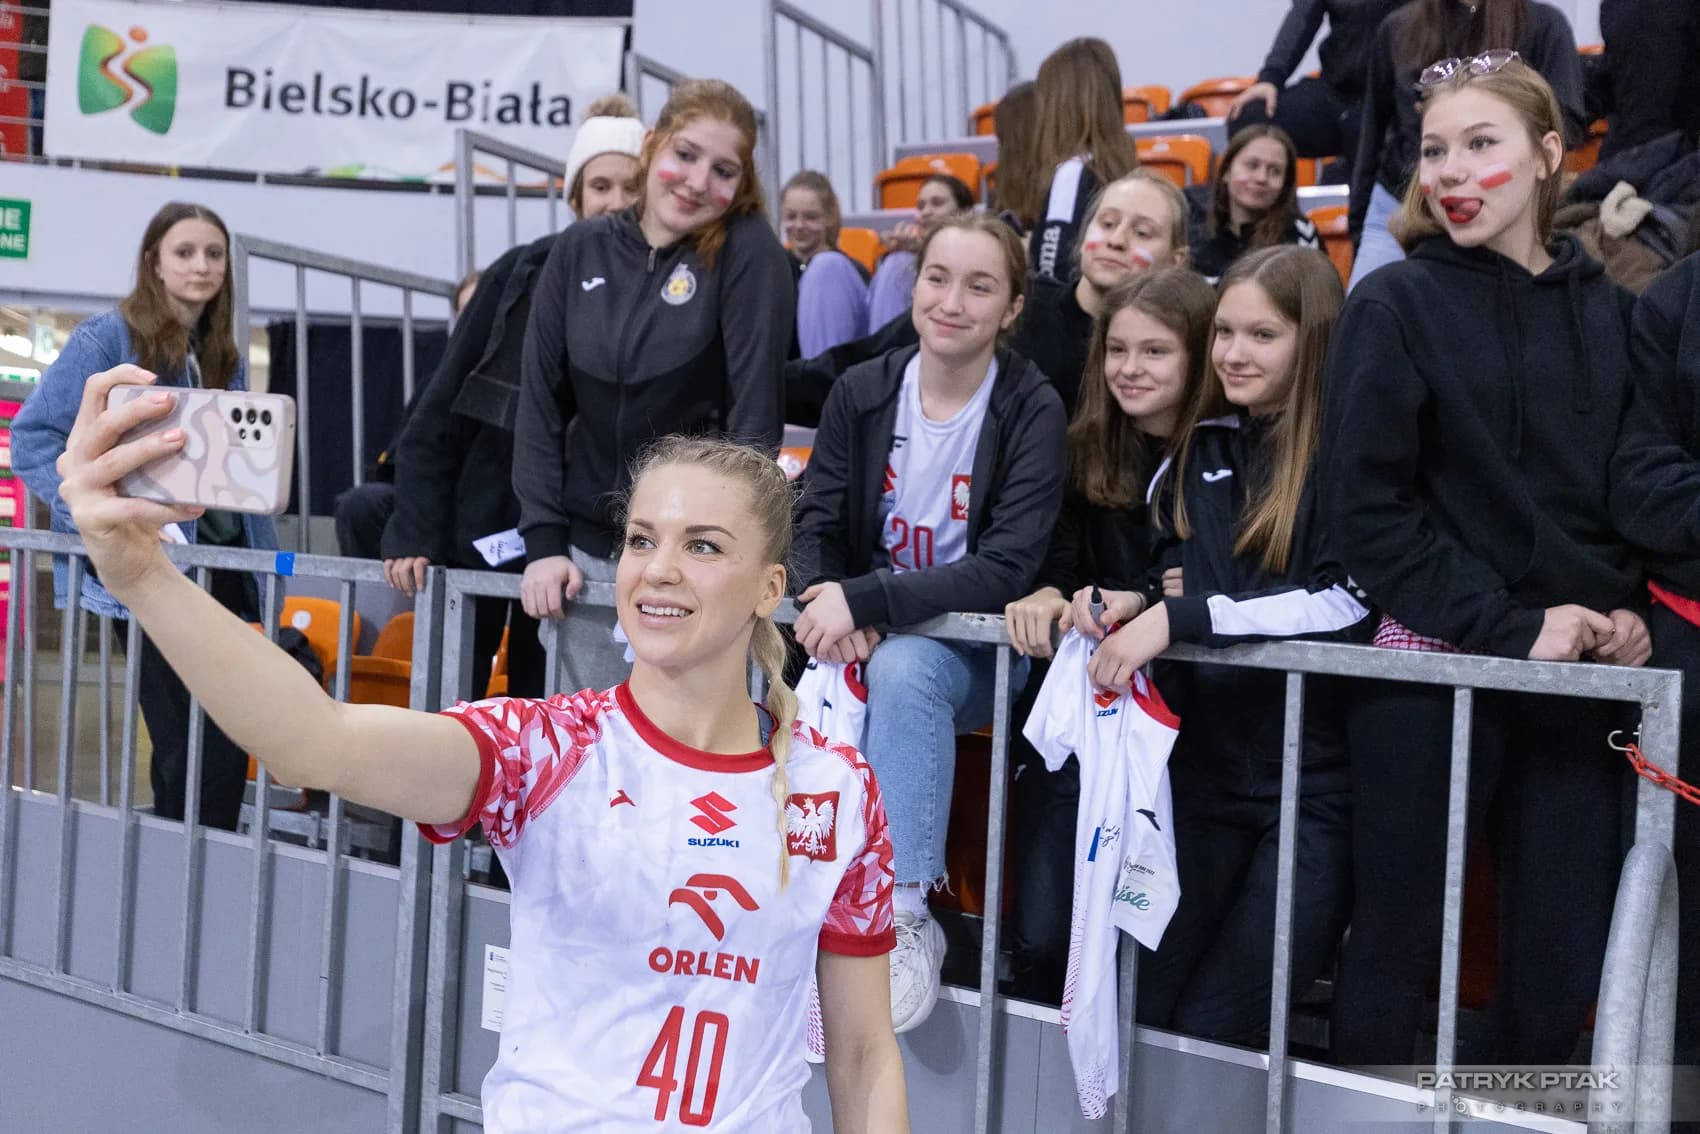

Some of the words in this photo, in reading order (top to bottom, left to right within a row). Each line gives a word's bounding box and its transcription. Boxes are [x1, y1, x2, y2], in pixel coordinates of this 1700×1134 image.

[225, 67, 572, 126] Bielsko-Biała
[890, 516, 933, 570] 20
[688, 838, 740, 848] SUZUKI
[648, 946, 760, 985] ORLEN
[636, 1005, 729, 1127] 40
